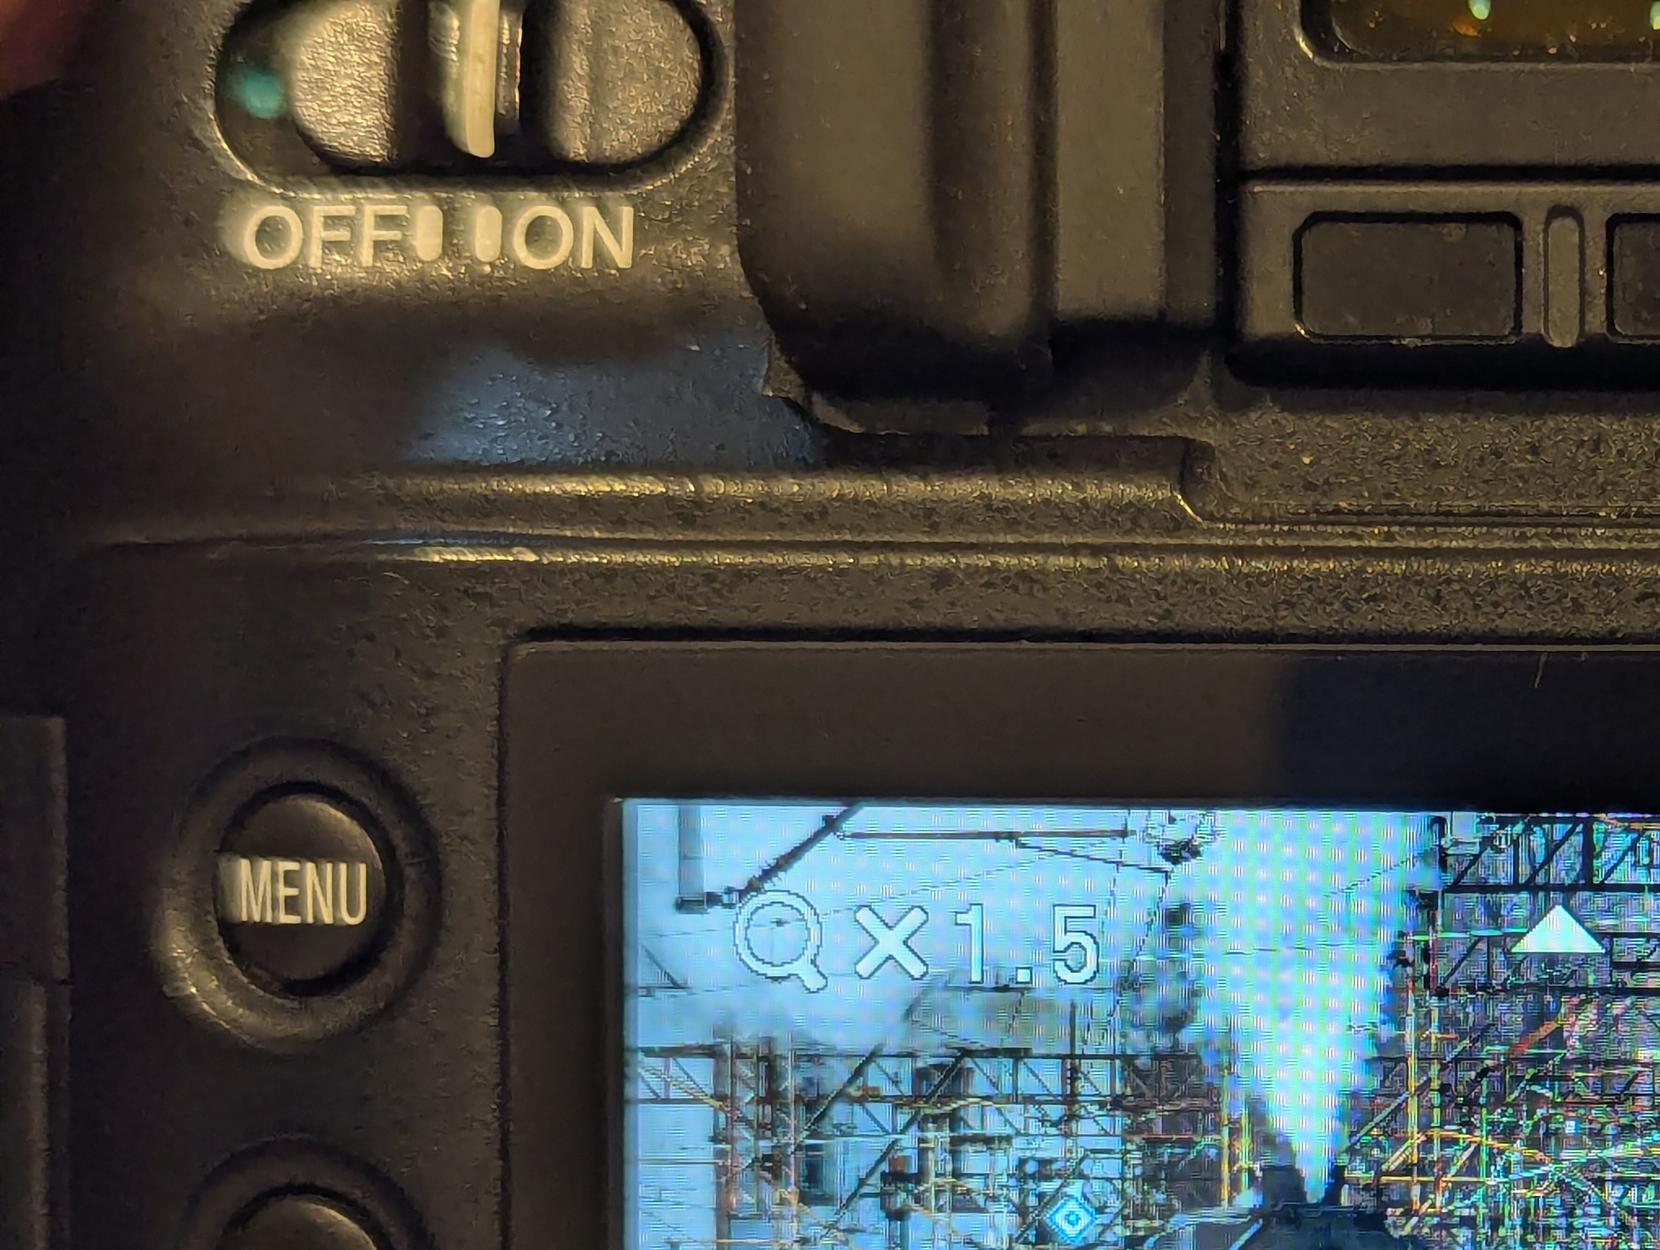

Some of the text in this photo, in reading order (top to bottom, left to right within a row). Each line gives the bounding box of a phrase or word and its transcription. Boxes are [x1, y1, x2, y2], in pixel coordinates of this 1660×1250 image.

[242, 204, 407, 270] OFF
[513, 205, 635, 269] ON
[239, 858, 368, 926] MENU
